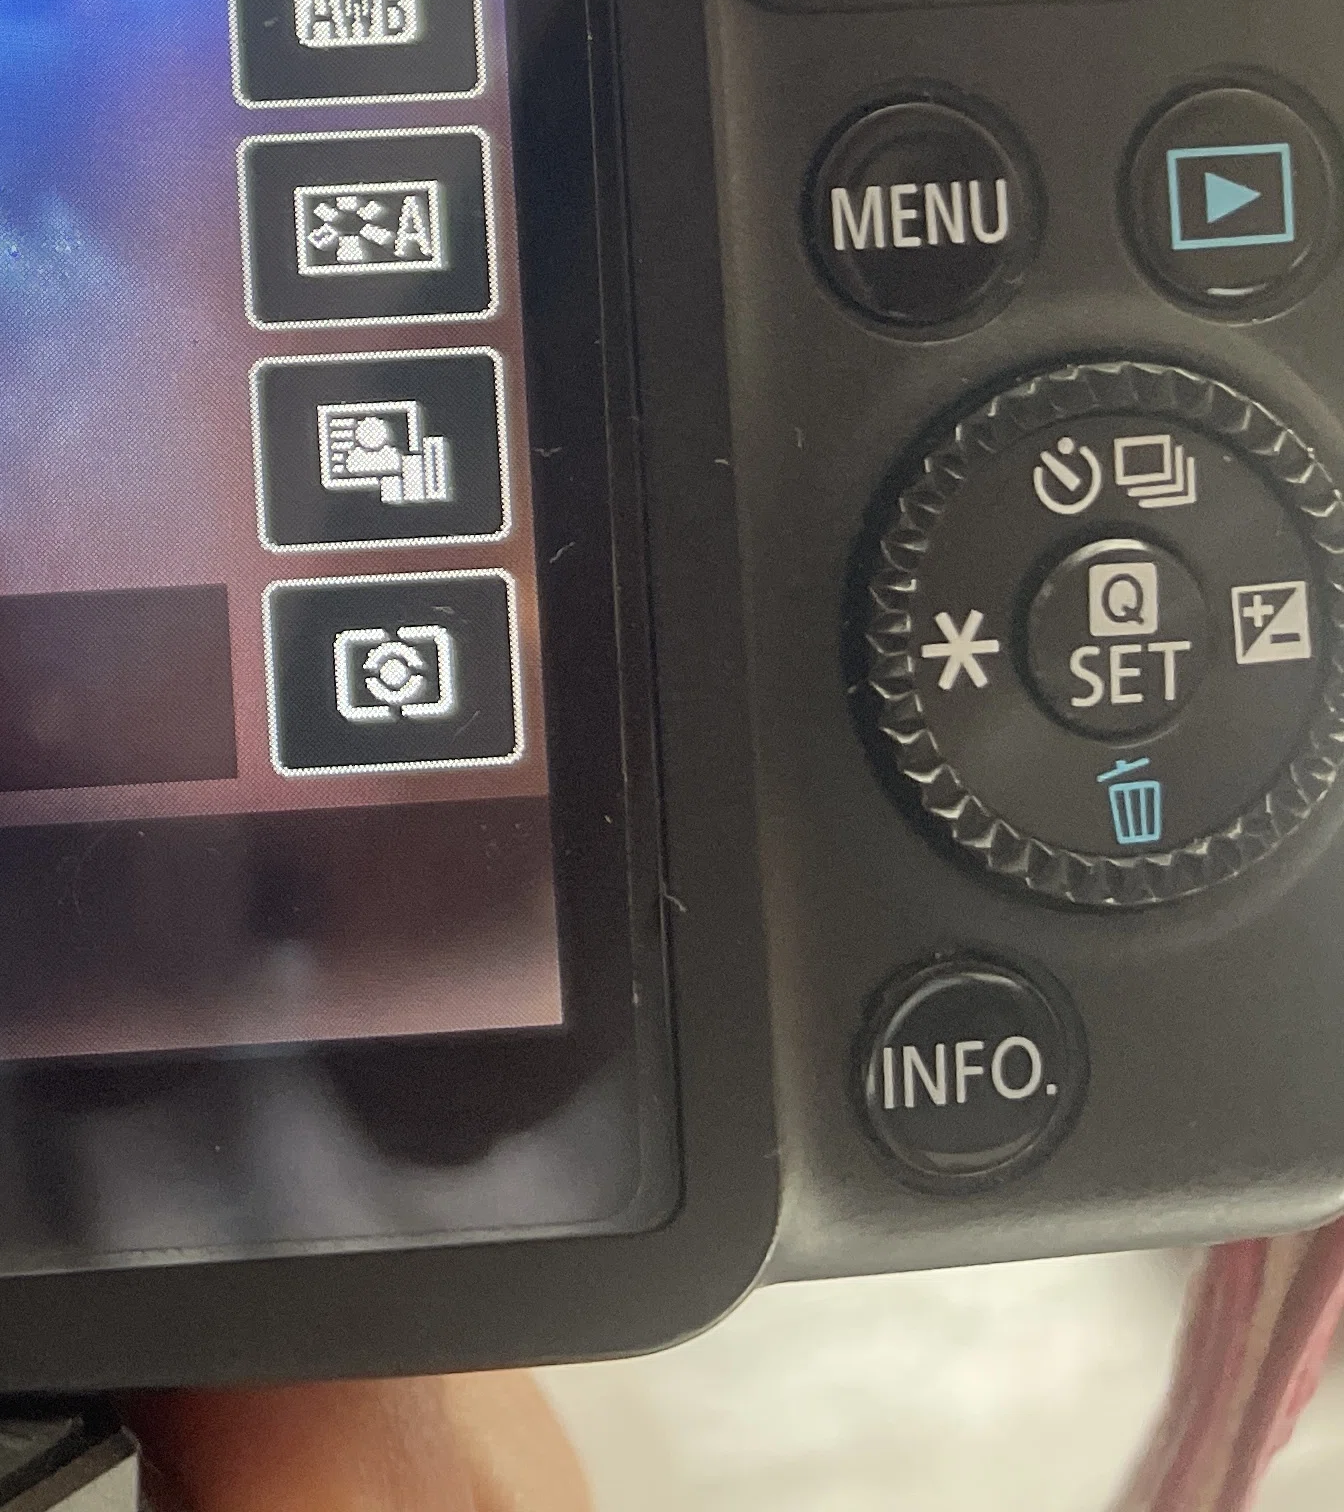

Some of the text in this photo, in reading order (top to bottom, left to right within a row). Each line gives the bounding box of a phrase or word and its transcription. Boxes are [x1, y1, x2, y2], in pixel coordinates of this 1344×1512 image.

[830, 178, 1010, 252] MENU
[1100, 572, 1145, 626] Q
[1068, 640, 1193, 709] SET
[882, 1034, 1059, 1110] INFO.
